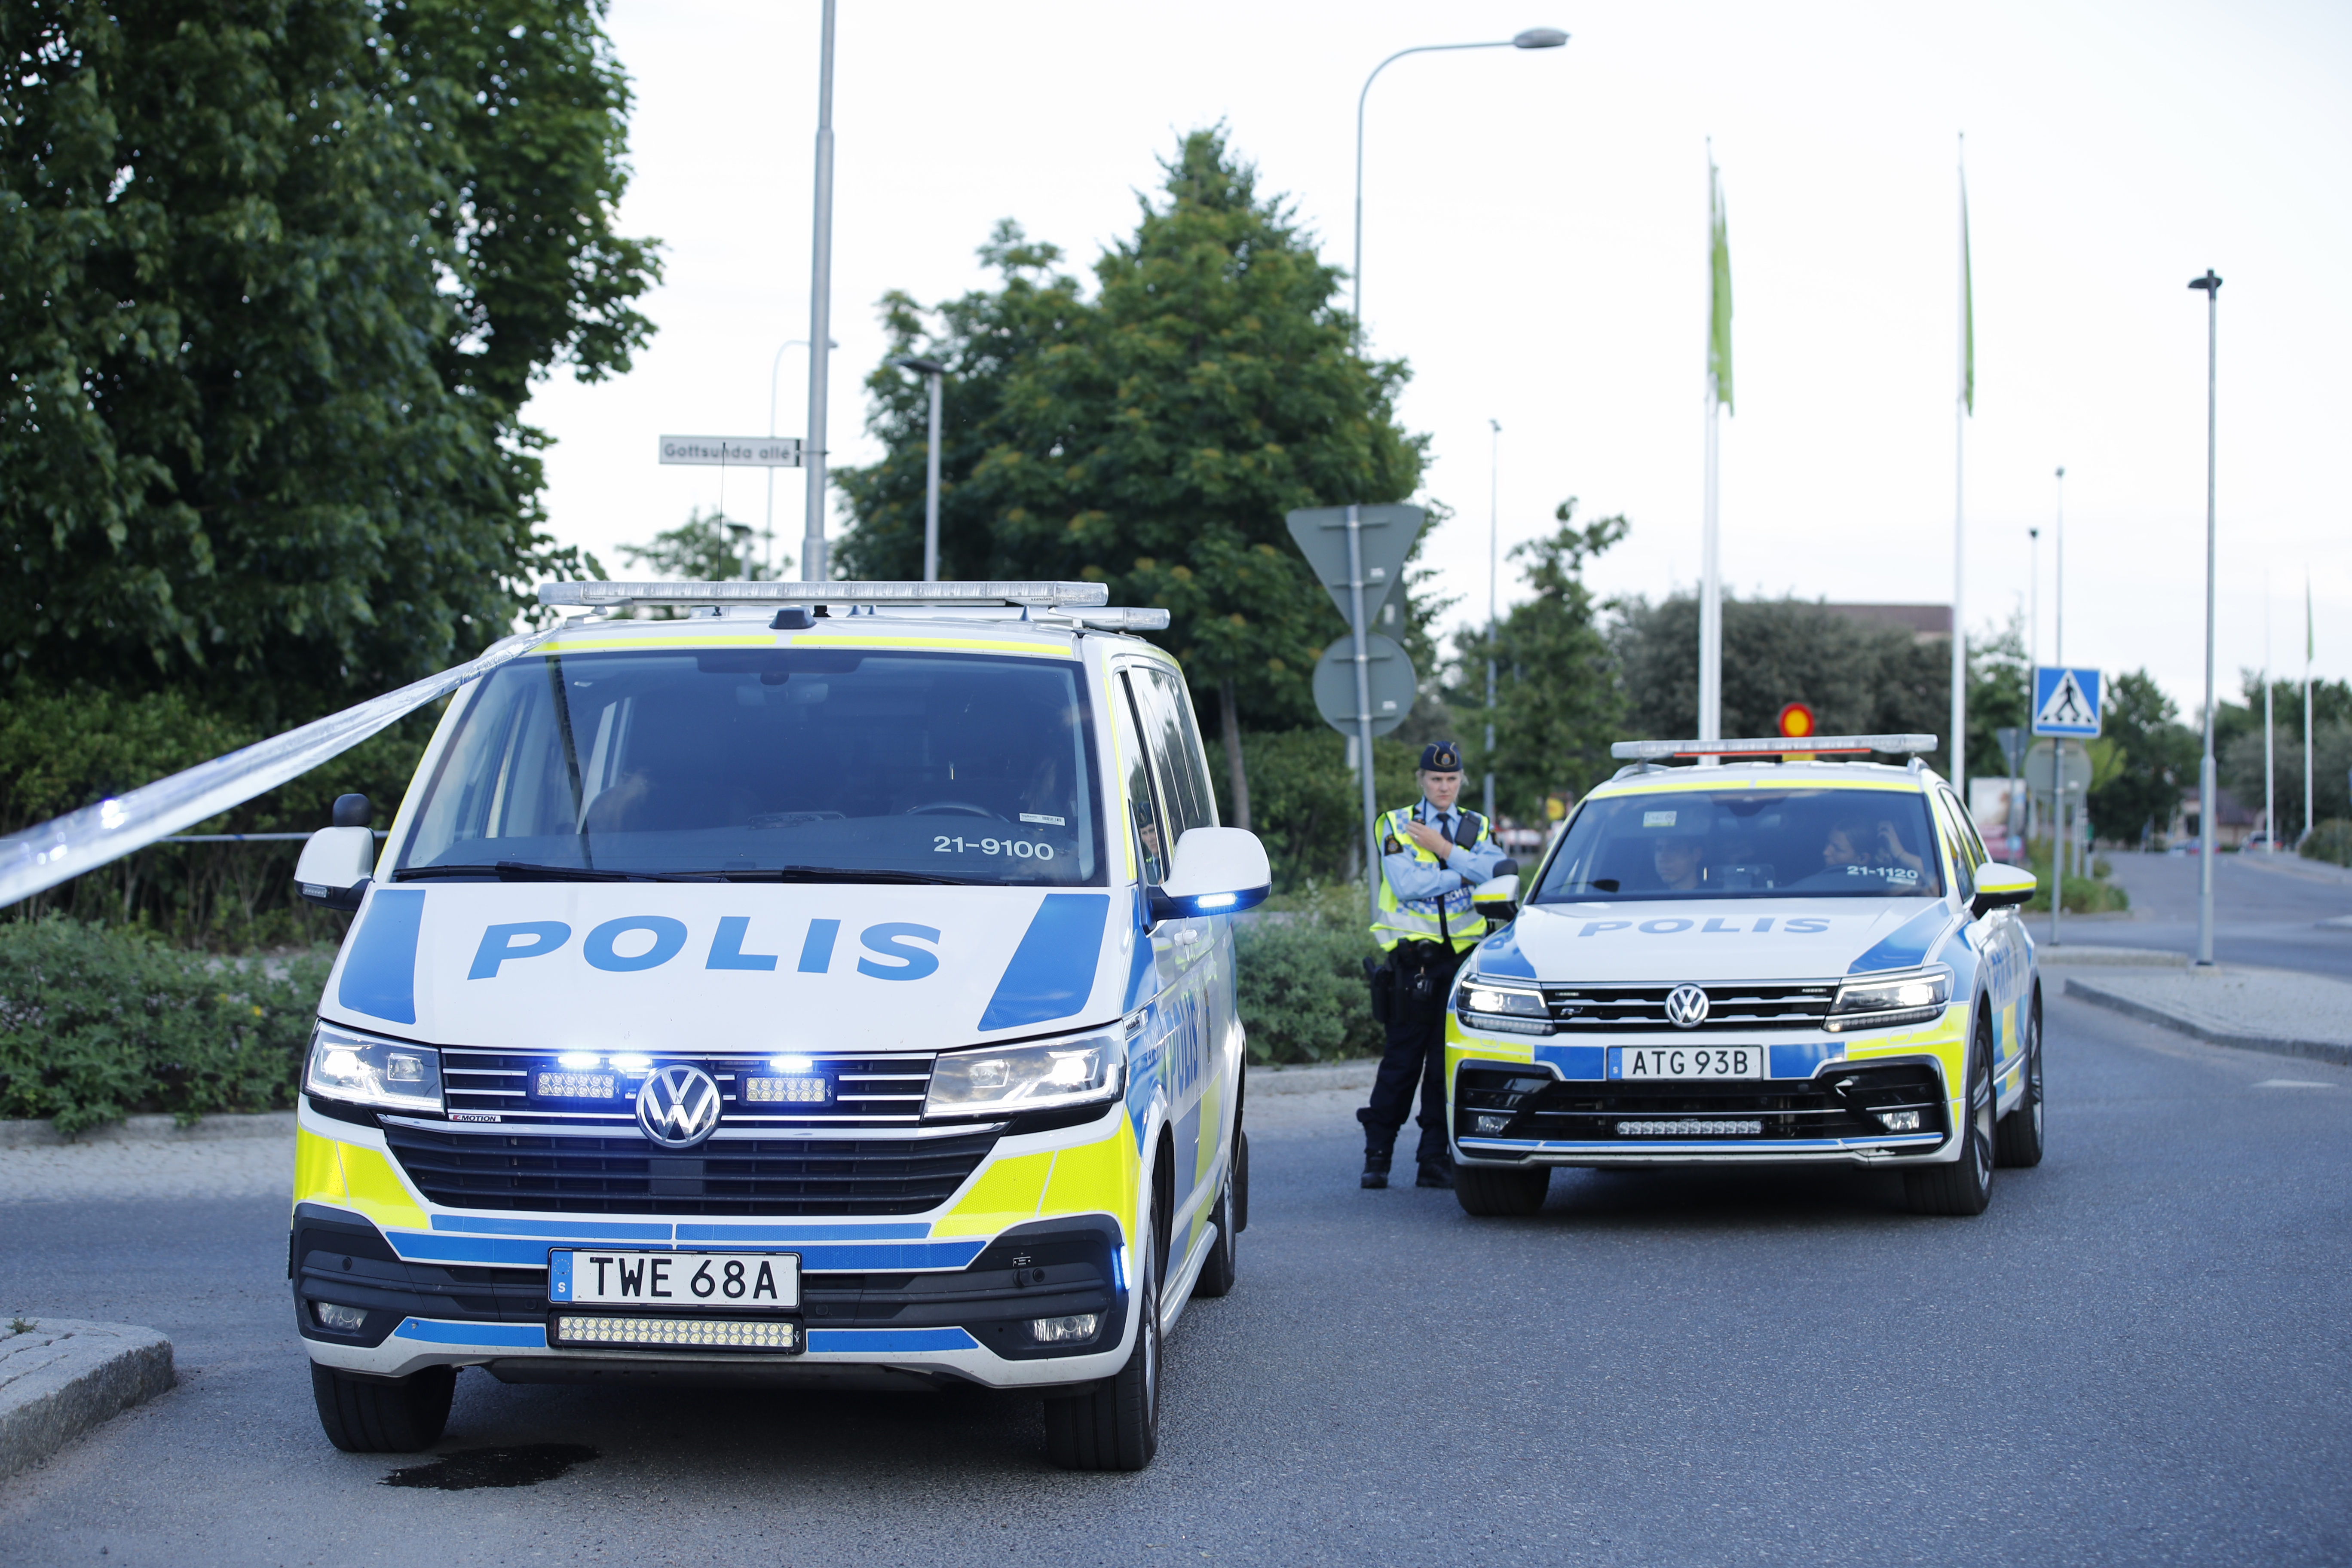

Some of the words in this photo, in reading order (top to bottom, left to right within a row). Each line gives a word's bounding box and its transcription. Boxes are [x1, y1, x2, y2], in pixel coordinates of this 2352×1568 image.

[665, 443, 752, 459] Gottsunda
[759, 445, 790, 459] allé
[934, 835, 1054, 861] 21-9100
[1847, 865, 1919, 879] 21-1120
[1577, 917, 1831, 937] POLIS
[467, 915, 941, 981] POLIS
[1164, 988, 1197, 1107] POLIS
[1633, 1050, 1684, 1075] ATG
[1695, 1050, 1748, 1075] 93B
[557, 1282, 567, 1293] S
[589, 1257, 672, 1297] TWE
[690, 1259, 778, 1299] 68A
